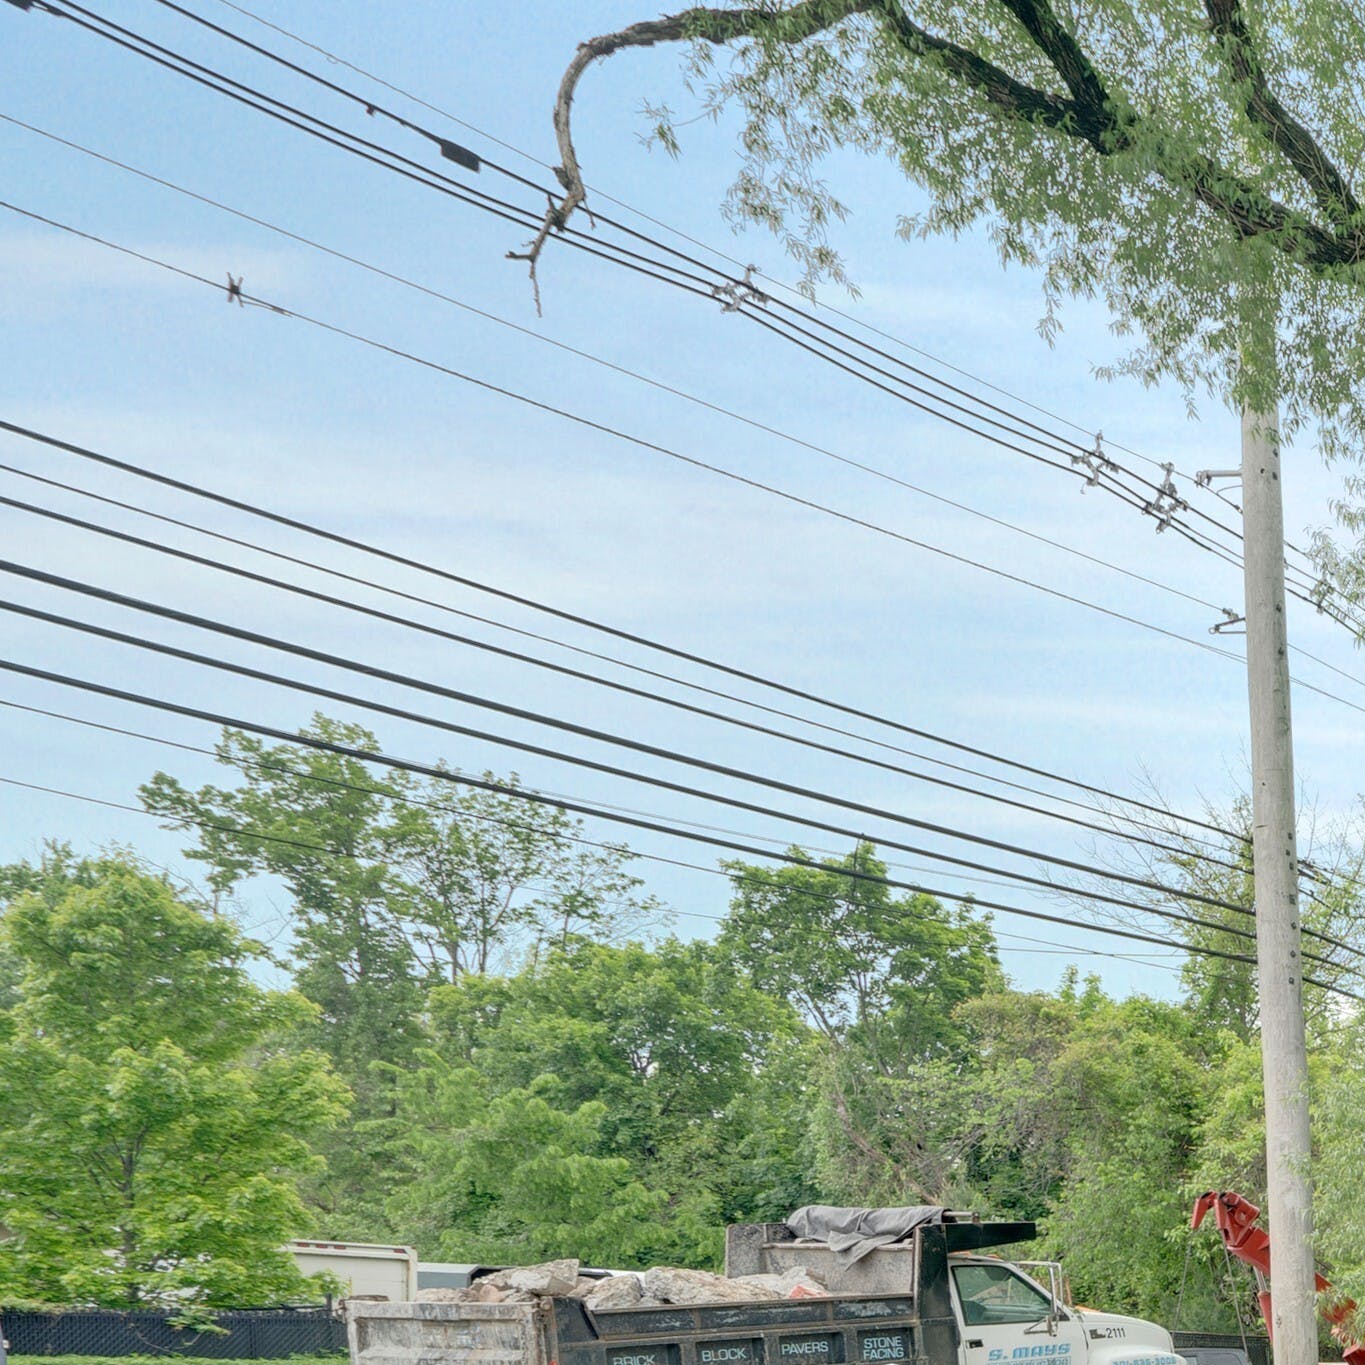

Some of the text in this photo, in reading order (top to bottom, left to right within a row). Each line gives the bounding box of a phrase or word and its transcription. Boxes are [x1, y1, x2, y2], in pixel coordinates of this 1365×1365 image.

[1105, 1327, 1126, 1339] 2111
[781, 1341, 829, 1355] PAVERS
[863, 1336, 903, 1349] STONE
[701, 1347, 747, 1362] BLOCK
[863, 1347, 905, 1360] FACING
[1012, 1343, 1071, 1359] MAYS
